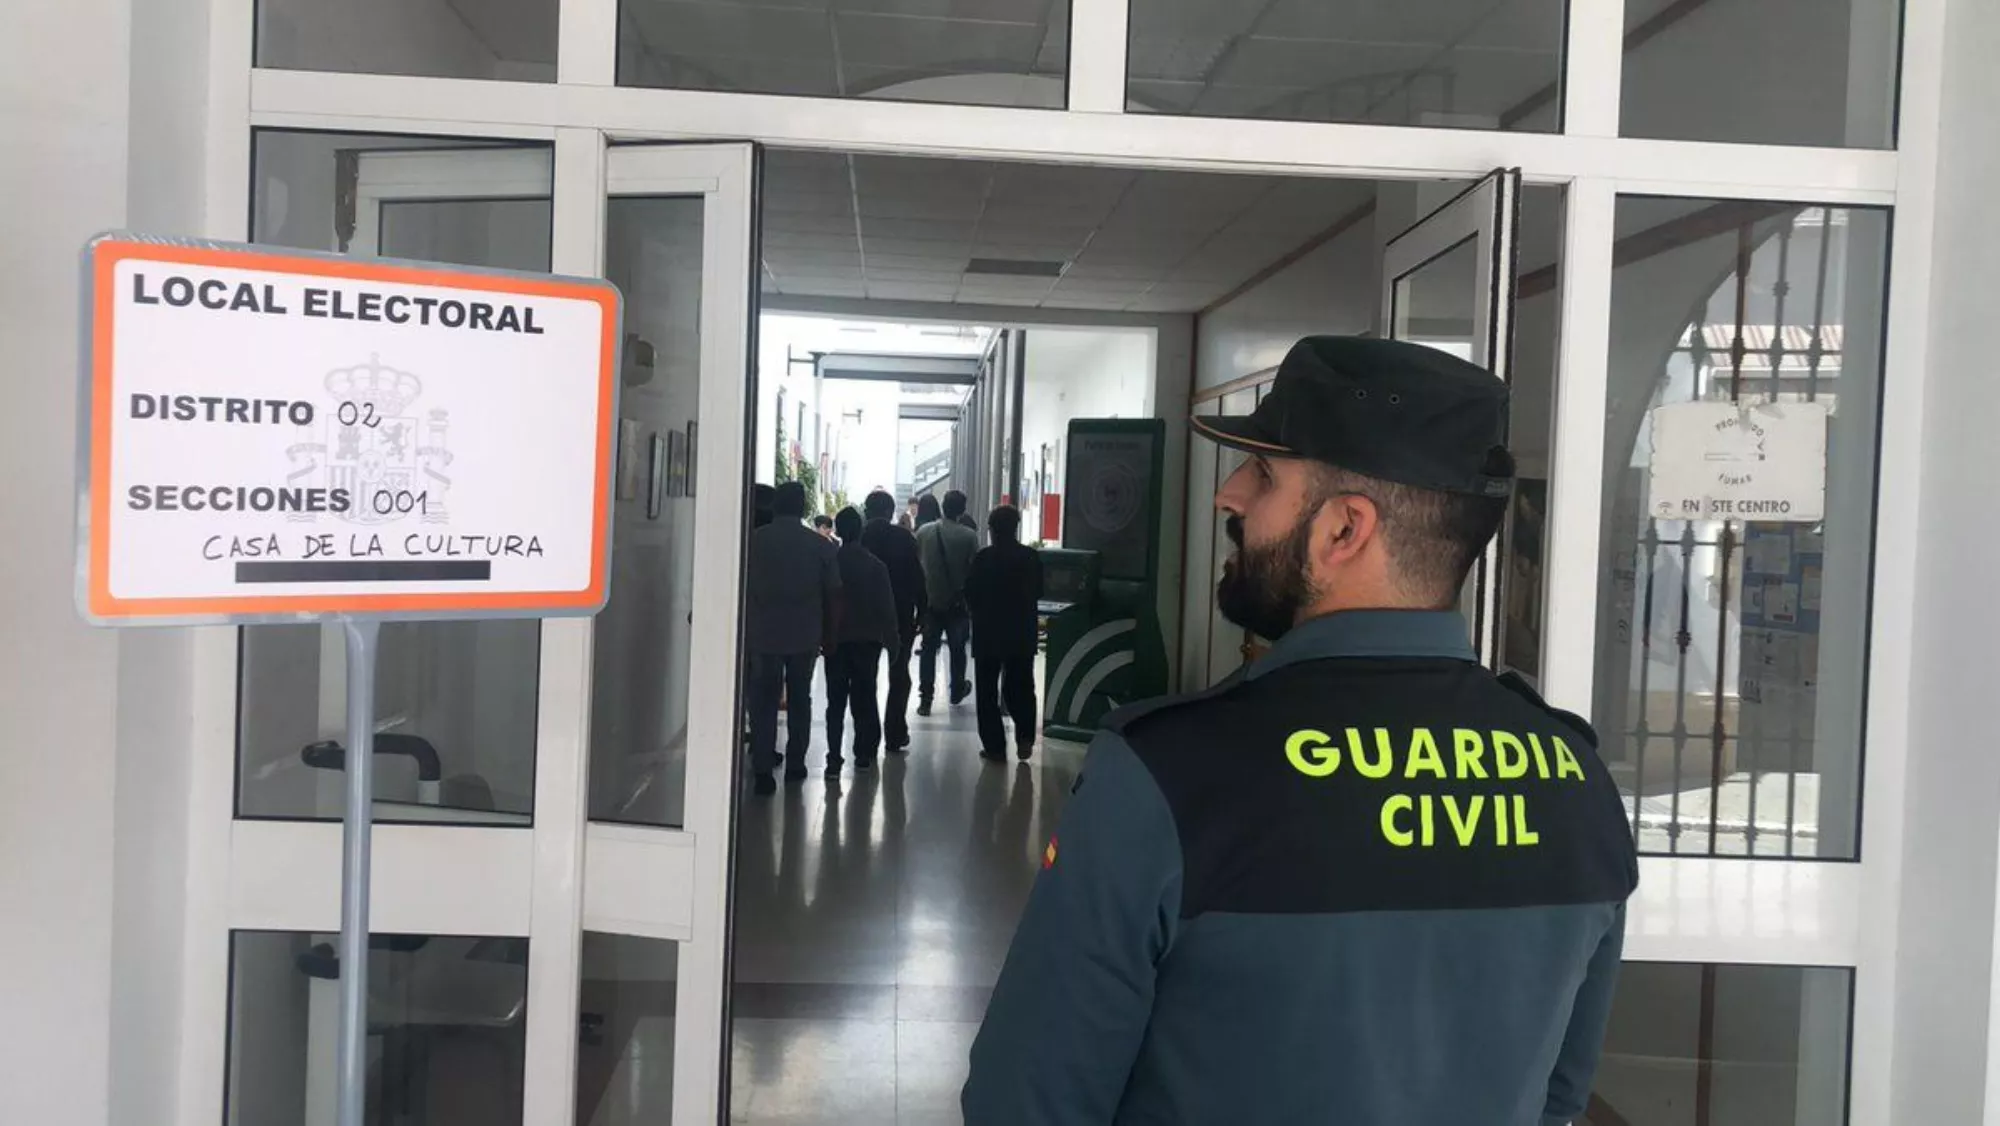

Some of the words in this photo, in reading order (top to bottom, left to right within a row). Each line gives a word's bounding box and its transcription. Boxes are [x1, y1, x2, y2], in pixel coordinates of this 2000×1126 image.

[133, 273, 287, 315] LOCAL
[303, 288, 545, 335] ELECTORAL
[130, 393, 314, 426] DISTRITO
[337, 401, 382, 429] 02
[128, 485, 351, 513] SECCIONES
[373, 489, 427, 515] 001
[1703, 499, 1732, 513] STE
[1738, 499, 1791, 513] CENTRO
[203, 534, 281, 560] CASA
[302, 534, 335, 559] DE
[350, 534, 383, 557] LA
[404, 533, 543, 557] CULTURA
[1284, 728, 1585, 781] GUARDIA
[1380, 794, 1539, 846] CIVIL
